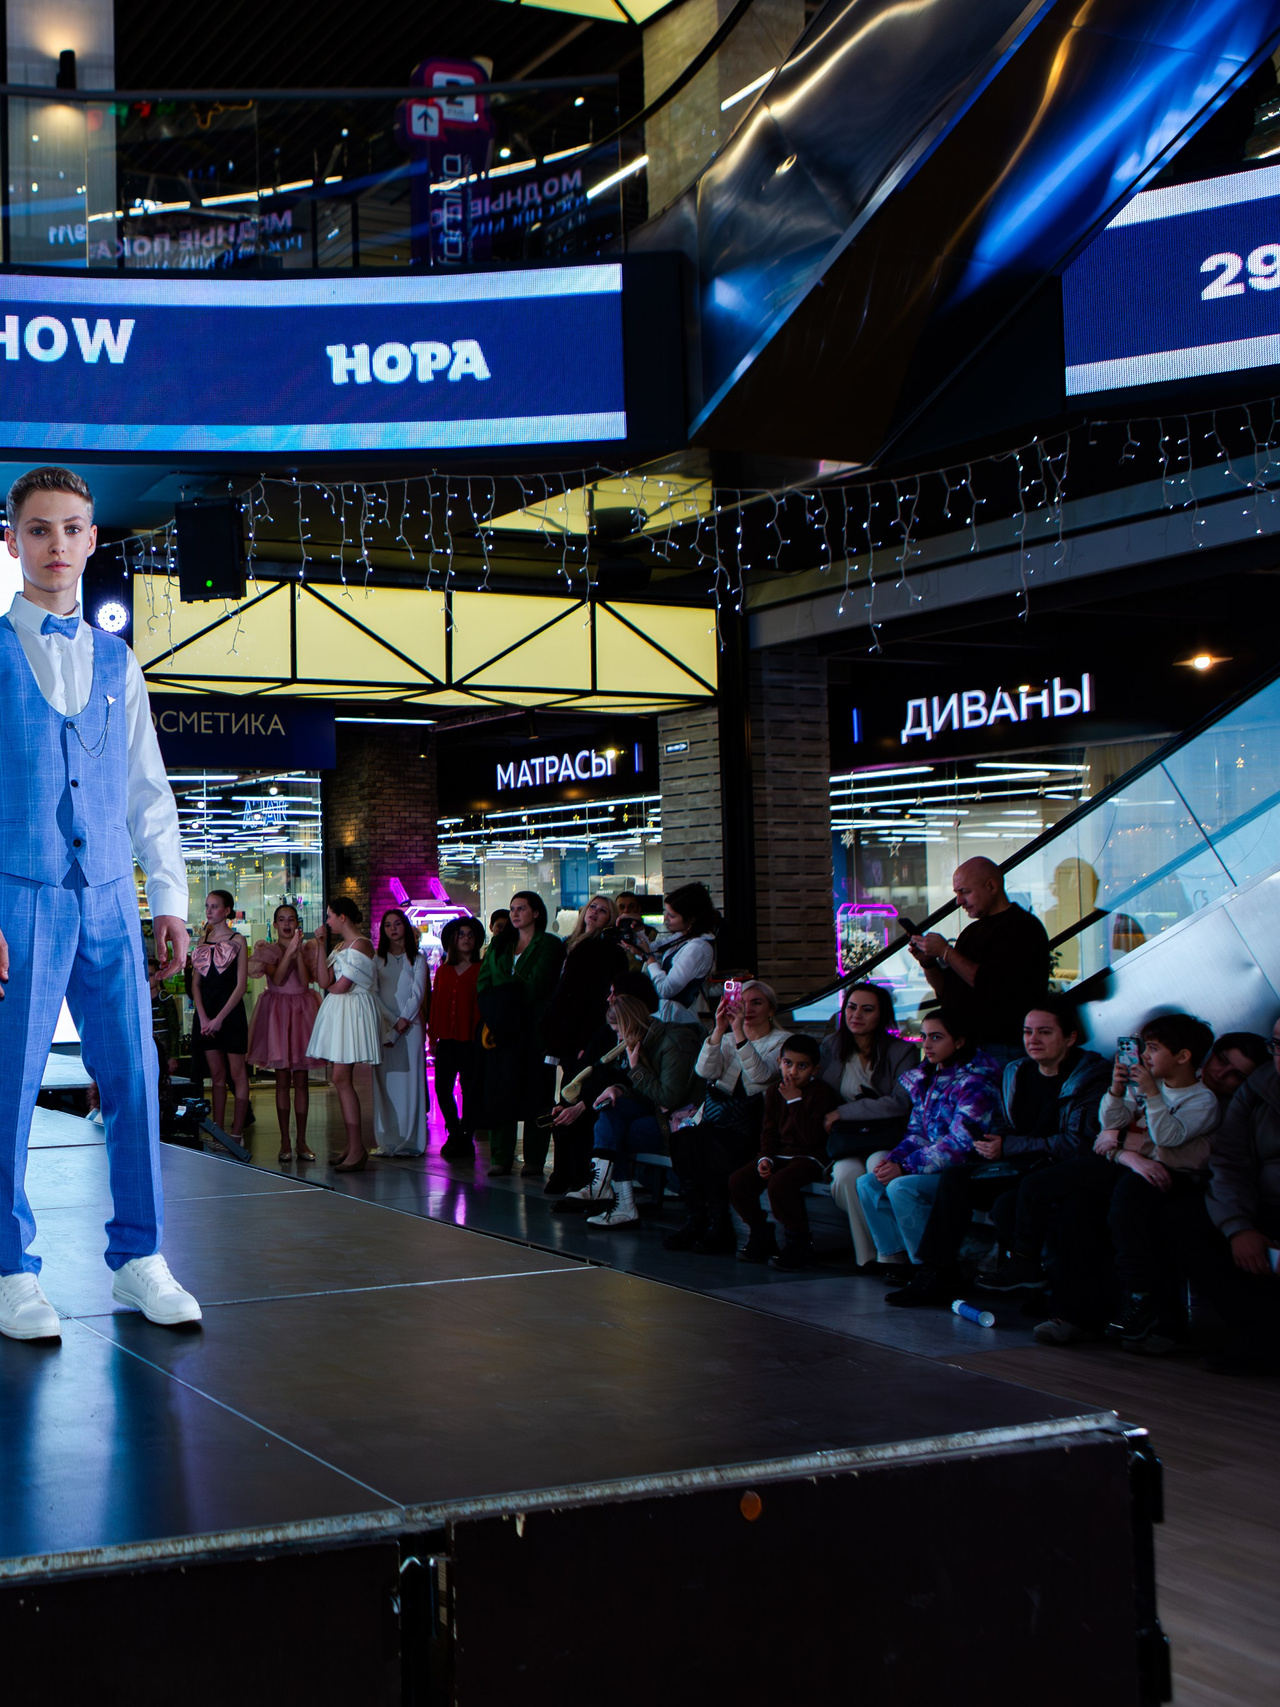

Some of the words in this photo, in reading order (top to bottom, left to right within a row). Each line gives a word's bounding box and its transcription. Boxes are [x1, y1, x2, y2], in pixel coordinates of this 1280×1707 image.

[437, 153, 463, 265] famiia
[1200, 243, 1280, 301] 29
[900, 672, 1091, 744] ДИВАНЫ
[496, 749, 617, 790] МАТРАСЫ
